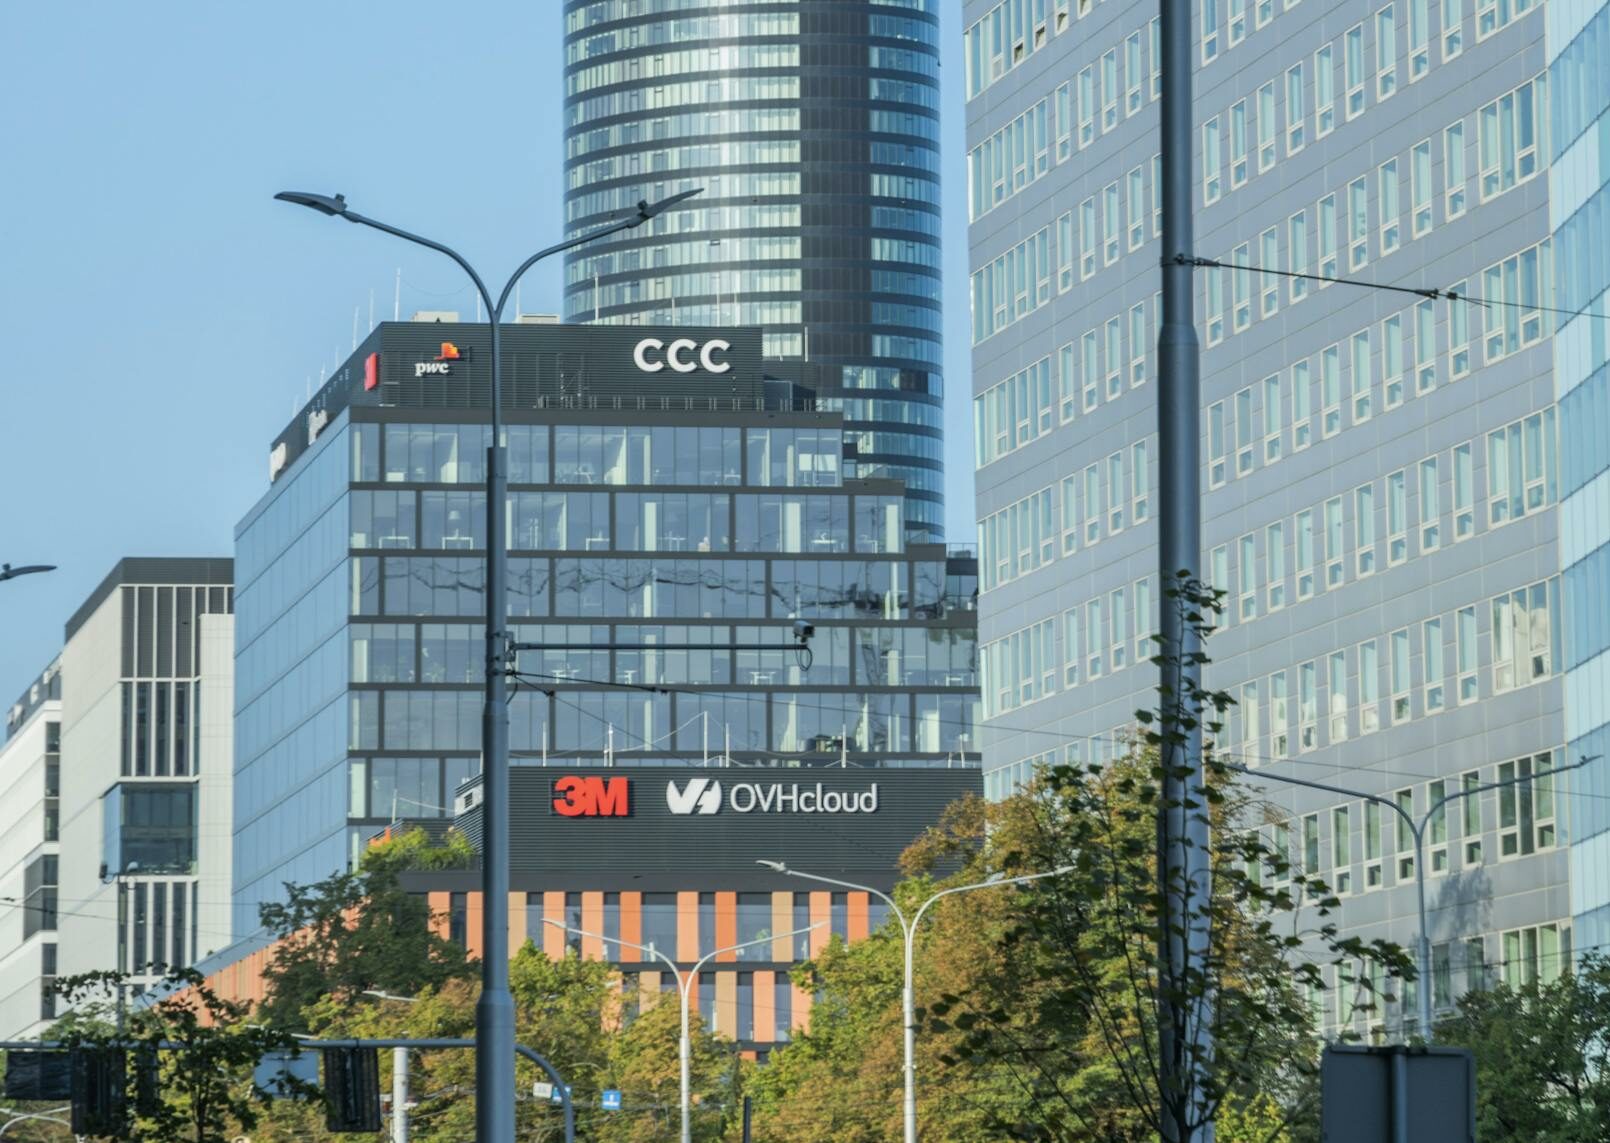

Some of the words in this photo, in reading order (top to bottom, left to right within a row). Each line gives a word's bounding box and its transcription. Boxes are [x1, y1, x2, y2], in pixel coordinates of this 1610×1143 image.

[414, 362, 449, 377] pwc
[633, 338, 731, 373] CCC
[553, 775, 629, 816] 3M
[730, 782, 878, 813] OVHcloud
